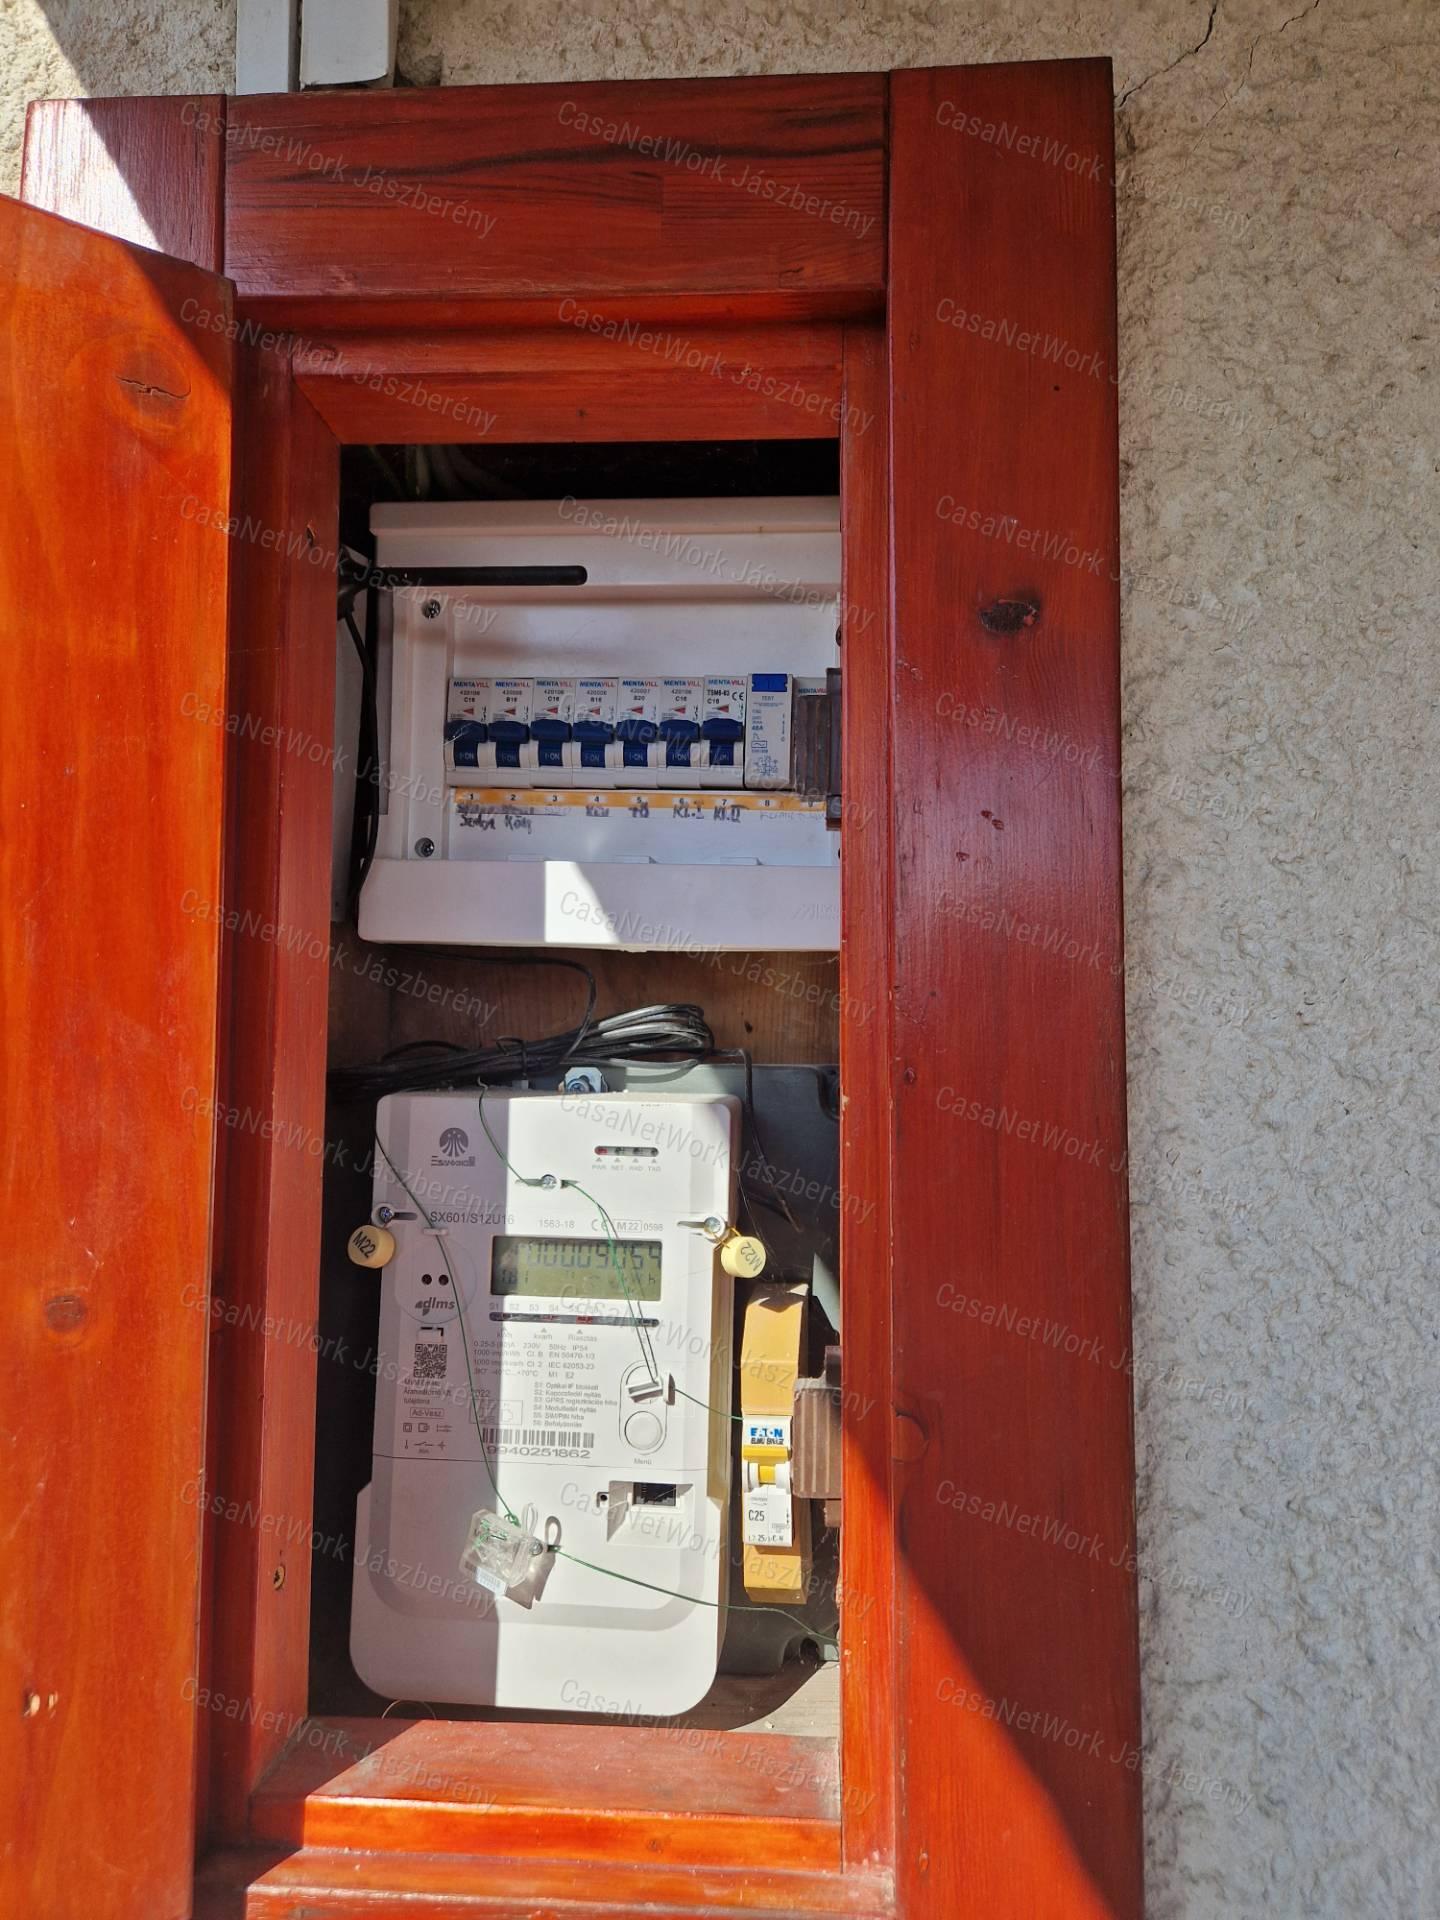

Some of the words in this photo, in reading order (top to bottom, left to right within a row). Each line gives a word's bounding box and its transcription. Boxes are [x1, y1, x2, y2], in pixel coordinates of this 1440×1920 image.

[708, 678, 745, 686] MENTAVILL
[539, 1219, 575, 1229] 1563-18
[352, 1231, 376, 1258] M22
[741, 1241, 762, 1271] M22
[748, 1509, 765, 1522] C25
